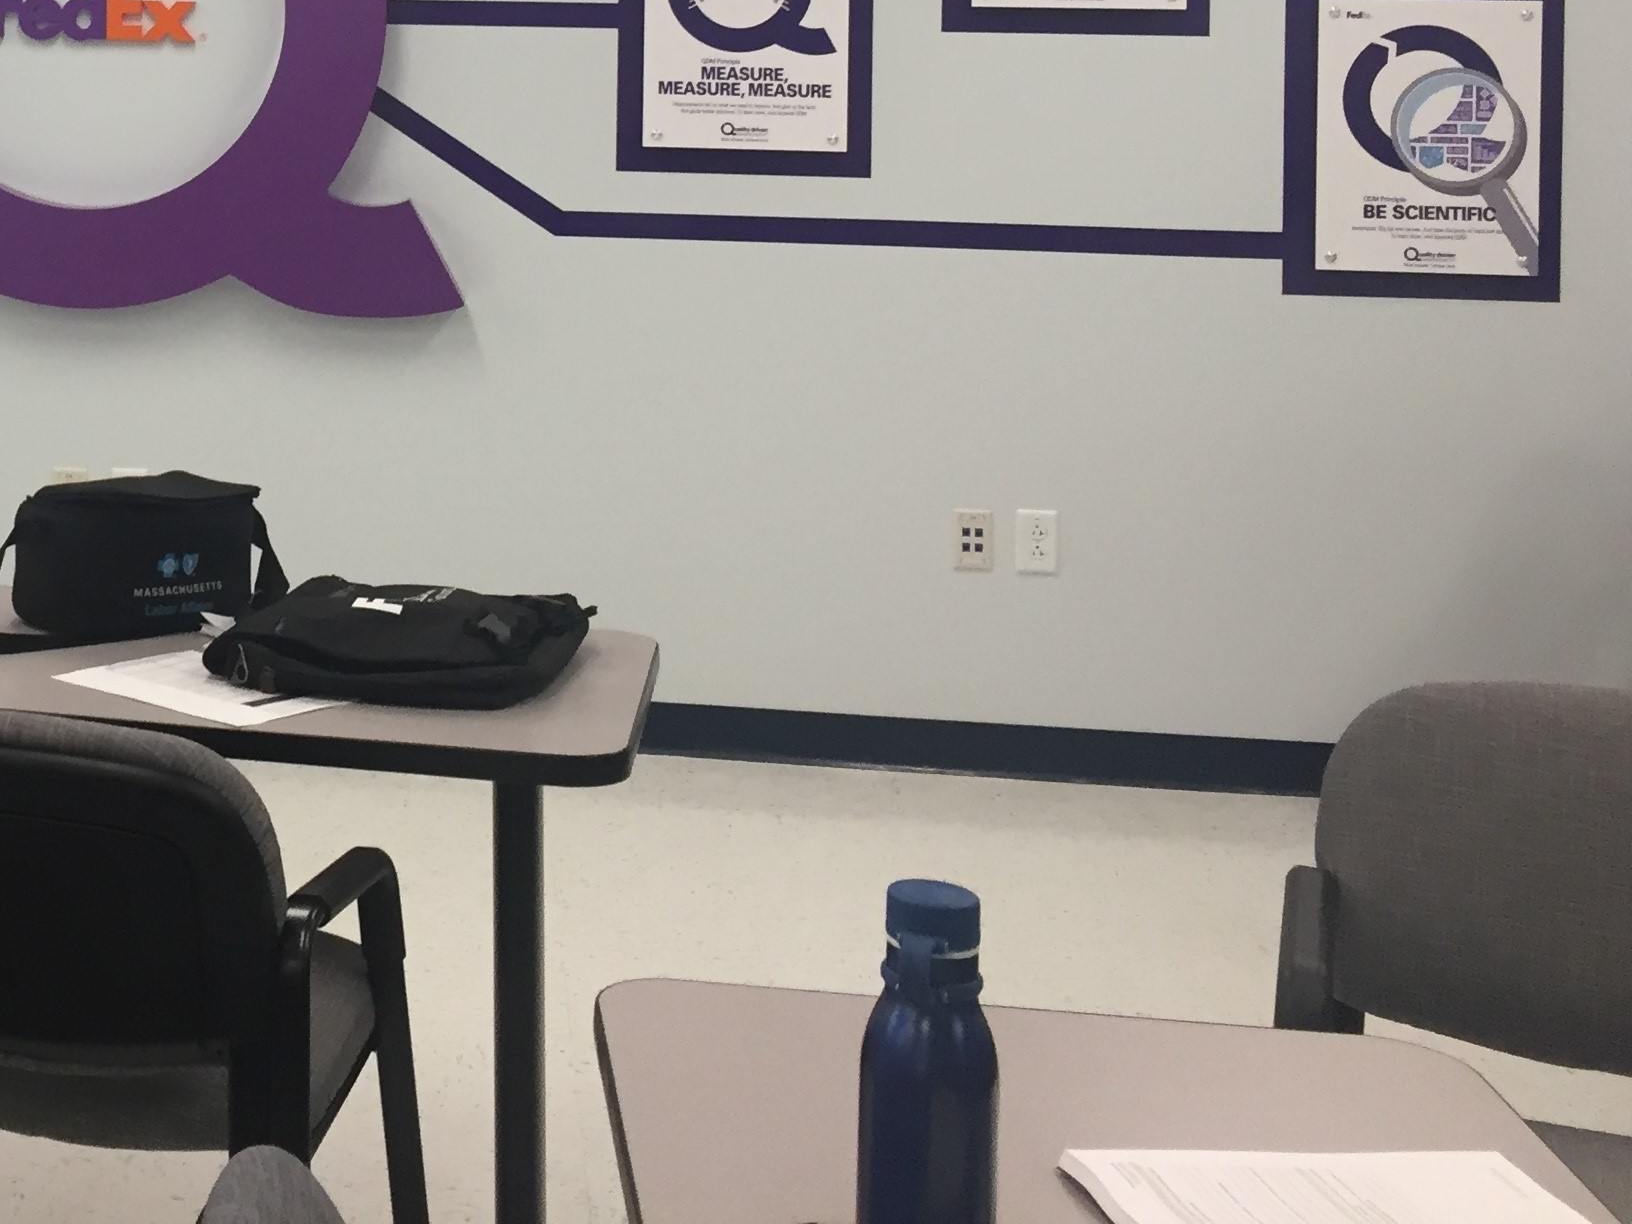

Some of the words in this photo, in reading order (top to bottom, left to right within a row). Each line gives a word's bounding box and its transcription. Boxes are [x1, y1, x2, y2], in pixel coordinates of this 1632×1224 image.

[701, 66, 789, 84] MEASURE,
[658, 81, 745, 98] MEASURE,
[748, 83, 832, 99] MEASURE
[1363, 204, 1387, 219] BE
[1392, 205, 1497, 222] SCIENTIFIC
[133, 580, 223, 597] MASSACHUSETTS
